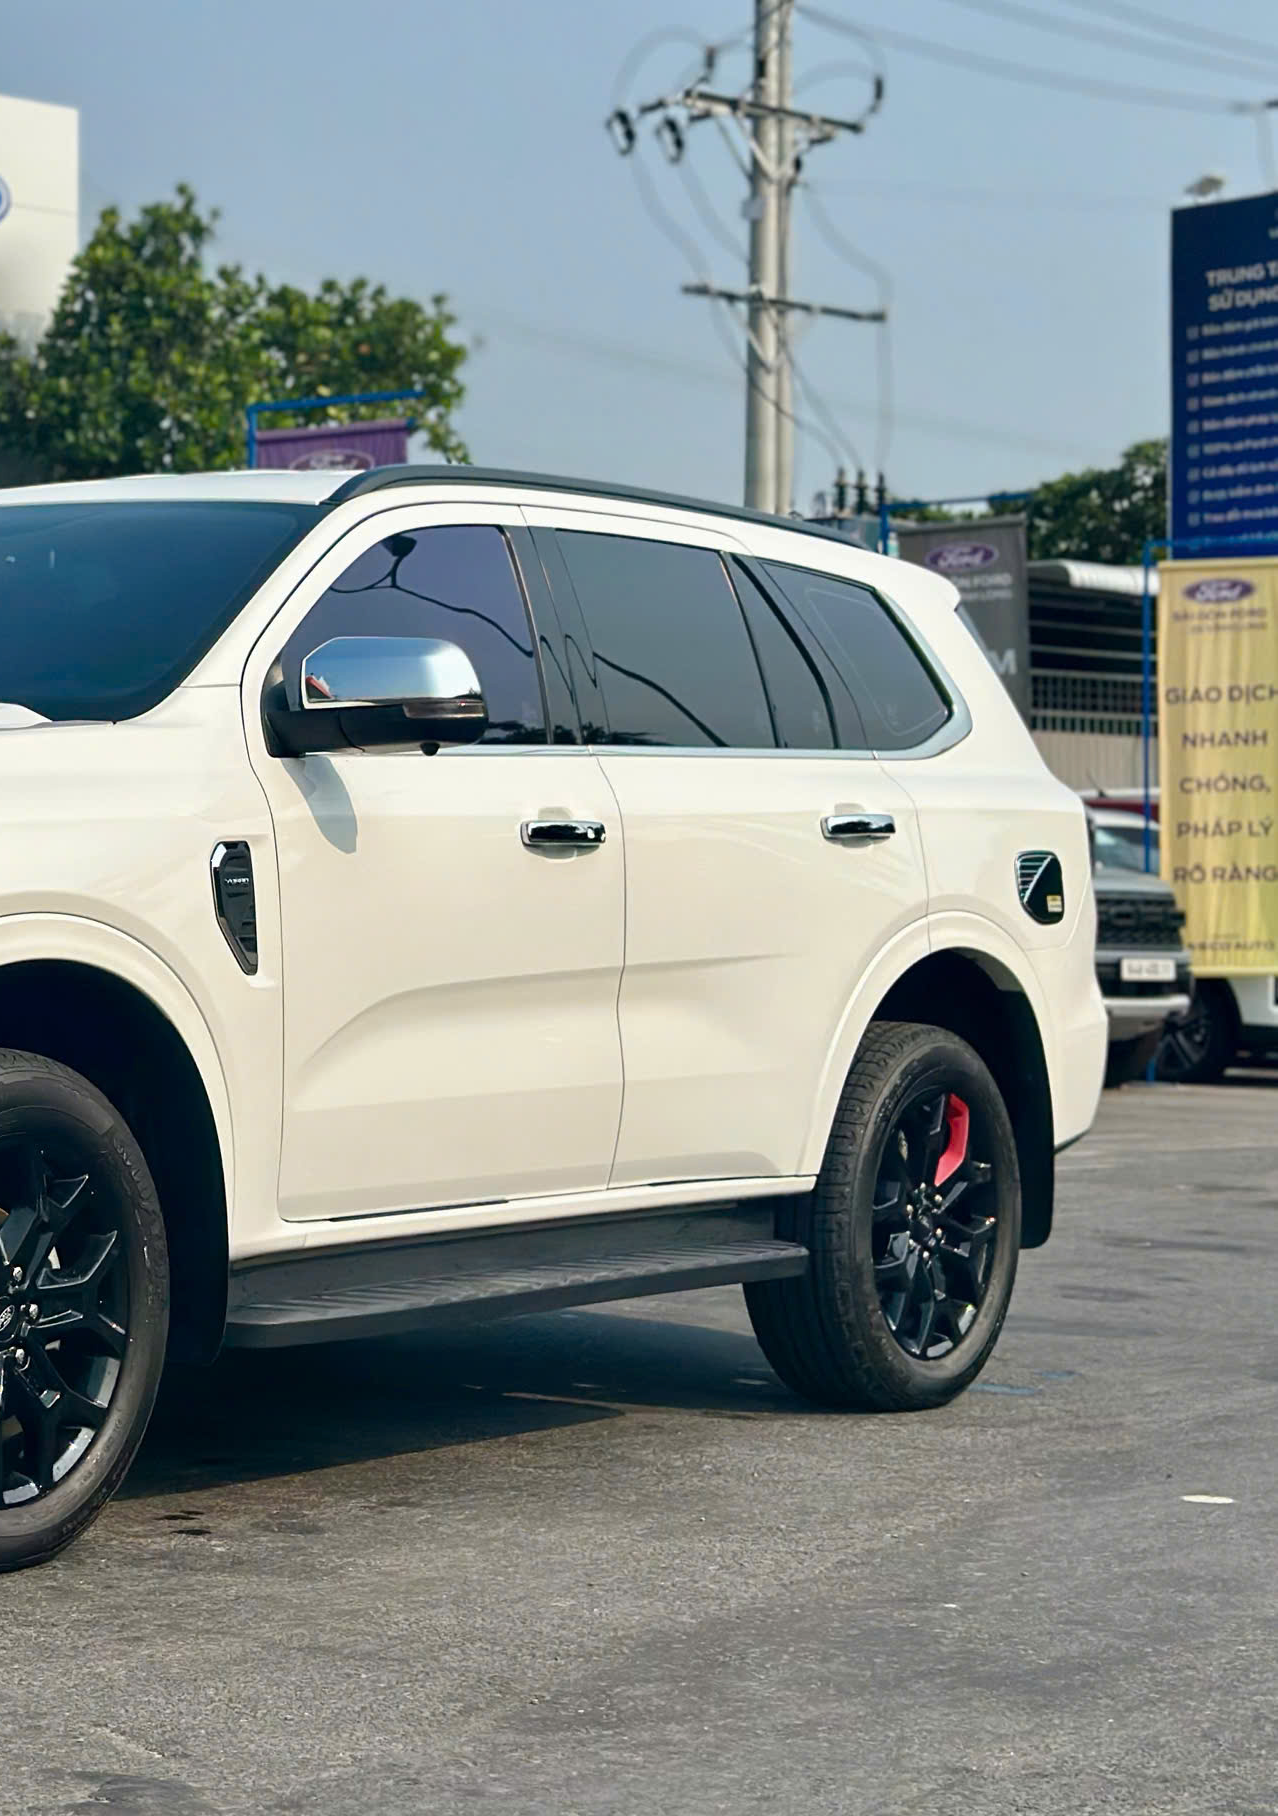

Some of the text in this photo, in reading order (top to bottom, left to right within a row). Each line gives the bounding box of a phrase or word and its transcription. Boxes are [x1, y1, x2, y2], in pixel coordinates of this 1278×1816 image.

[1166, 686, 1222, 705] GIAO
[1182, 730, 1268, 750] NHANH
[1179, 771, 1271, 794] CHÓNG,
[1177, 814, 1274, 839] PHÁP LÝ
